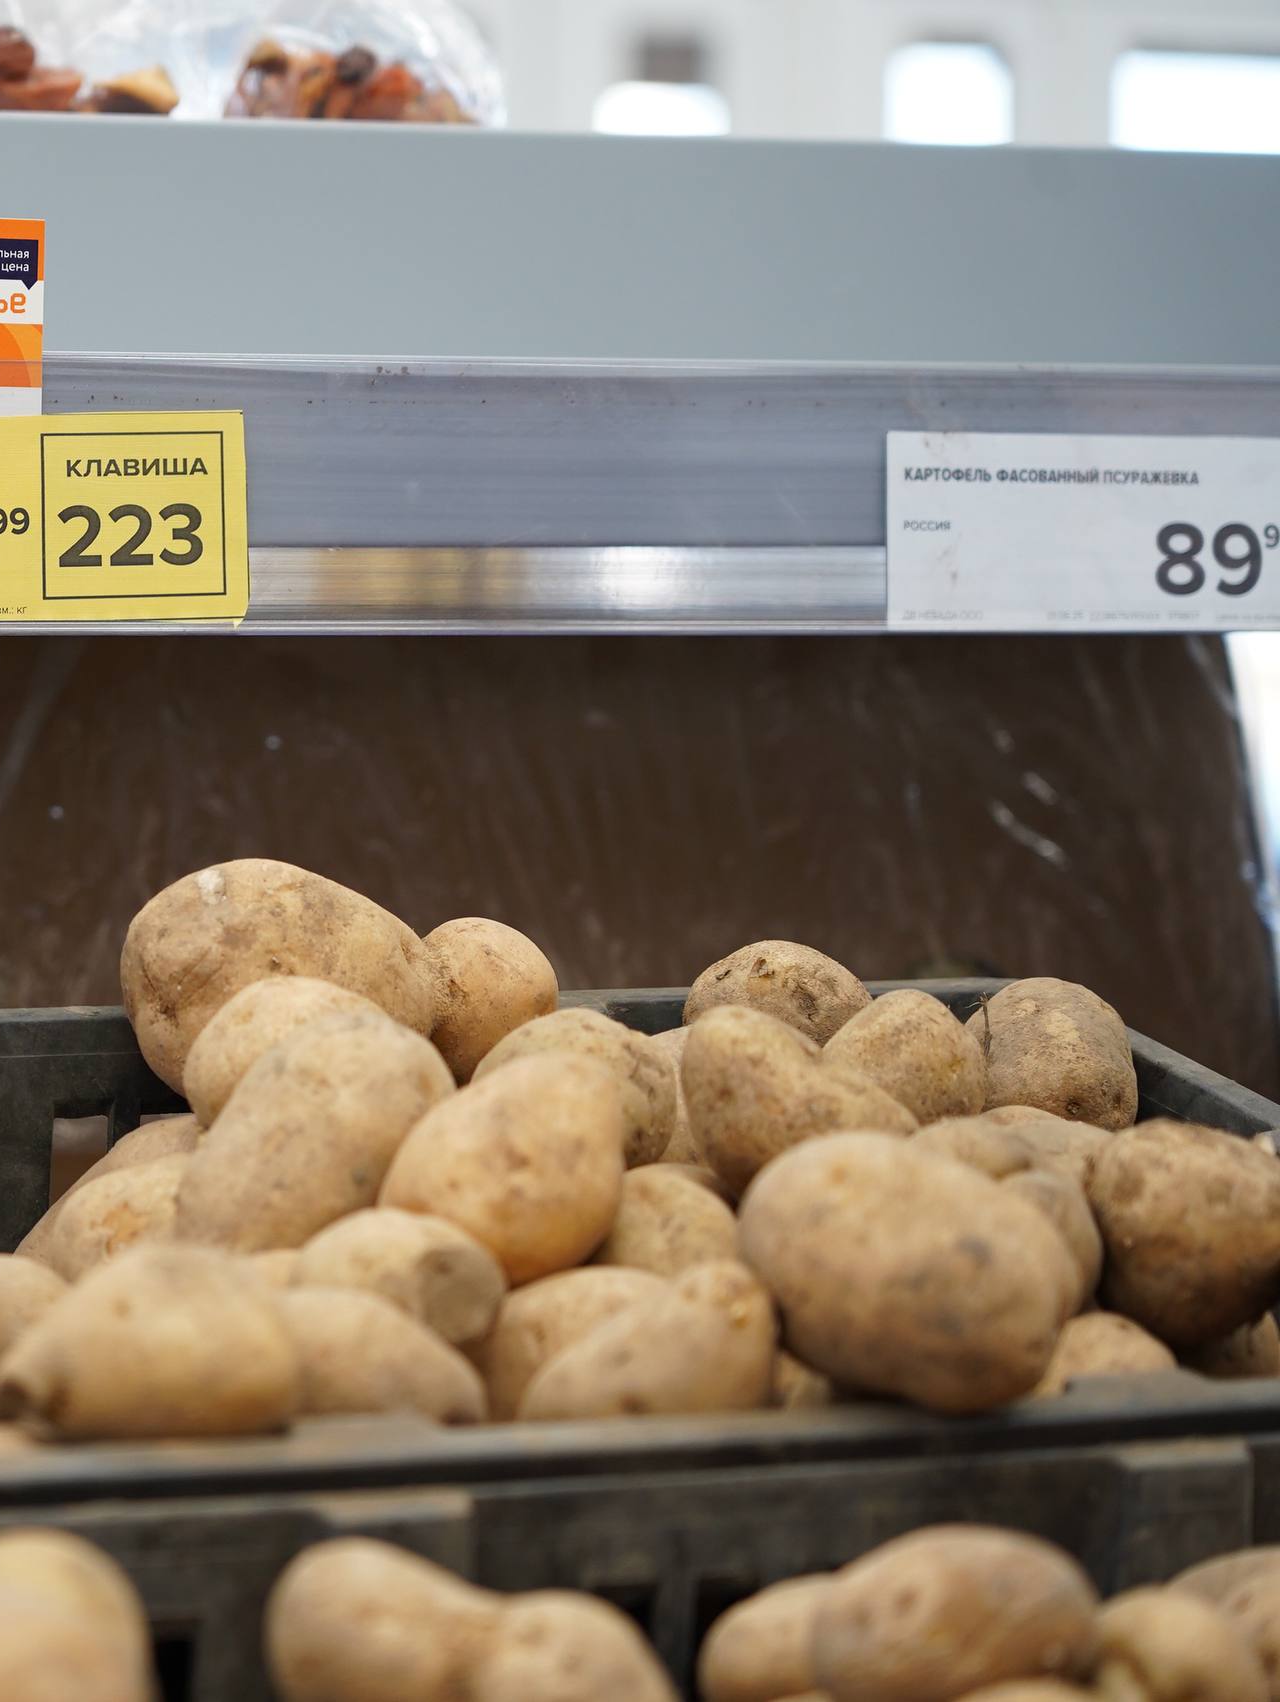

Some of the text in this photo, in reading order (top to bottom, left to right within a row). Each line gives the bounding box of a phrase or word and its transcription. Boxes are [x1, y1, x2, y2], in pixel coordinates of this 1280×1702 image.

[1, 262, 30, 273] цена
[66, 457, 208, 477] КЛАВИША
[904, 467, 992, 482] КАРТОФЕЛЬ
[996, 466, 1099, 484] ФАСОВАННЫЙ
[904, 520, 951, 531] РОССИЯ
[57, 503, 204, 568] 223
[16, 606, 27, 615] кг
